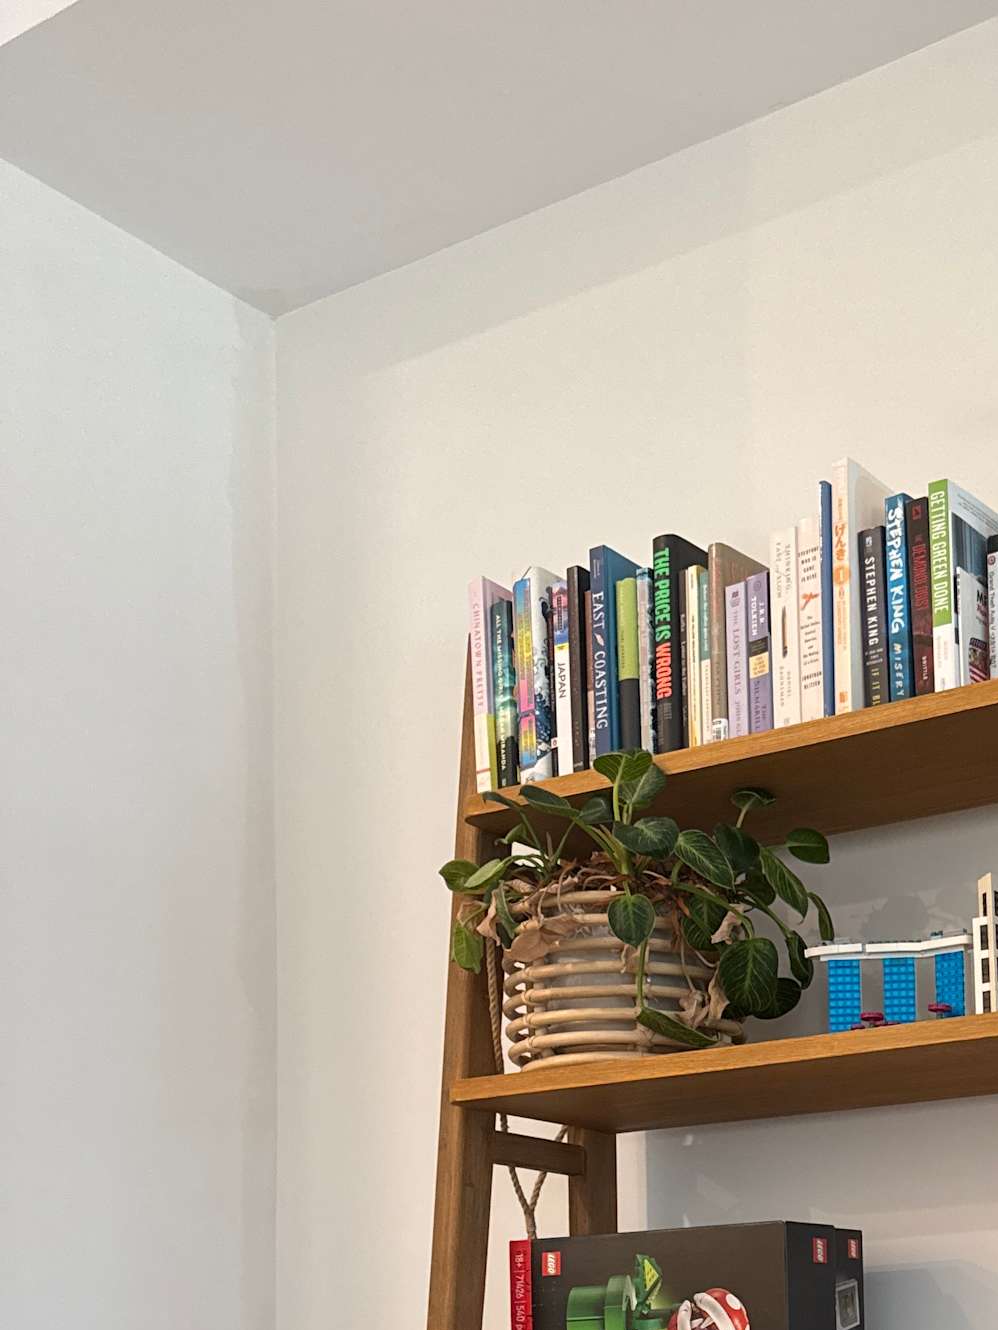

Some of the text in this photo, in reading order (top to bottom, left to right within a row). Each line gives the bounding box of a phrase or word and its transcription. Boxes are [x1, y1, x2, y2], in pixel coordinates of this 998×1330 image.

[930, 491, 949, 614] GETTING GREEN DONE
[864, 557, 878, 612] STEPHEN
[886, 504, 905, 696] STEPHEN KING MISERY
[592, 591, 606, 629] EAST
[654, 547, 672, 699] THE PRICE IS WRONG
[750, 596, 758, 636] TOLKIEN
[472, 603, 483, 667] CHINATOWN
[732, 628, 741, 656] LOST
[866, 616, 879, 646] KING
[557, 662, 567, 699] JAPAN
[733, 660, 741, 695] GIRLS
[871, 667, 880, 676] IF
[872, 681, 881, 690] IT
[921, 655, 929, 680] BRITTLE
[598, 651, 609, 730] COASTING
[547, 1253, 557, 1275] LEGO
[815, 1239, 825, 1263] LEGO
[848, 1240, 857, 1257] LEGO
[515, 1253, 526, 1322] 18+ 71426 540
